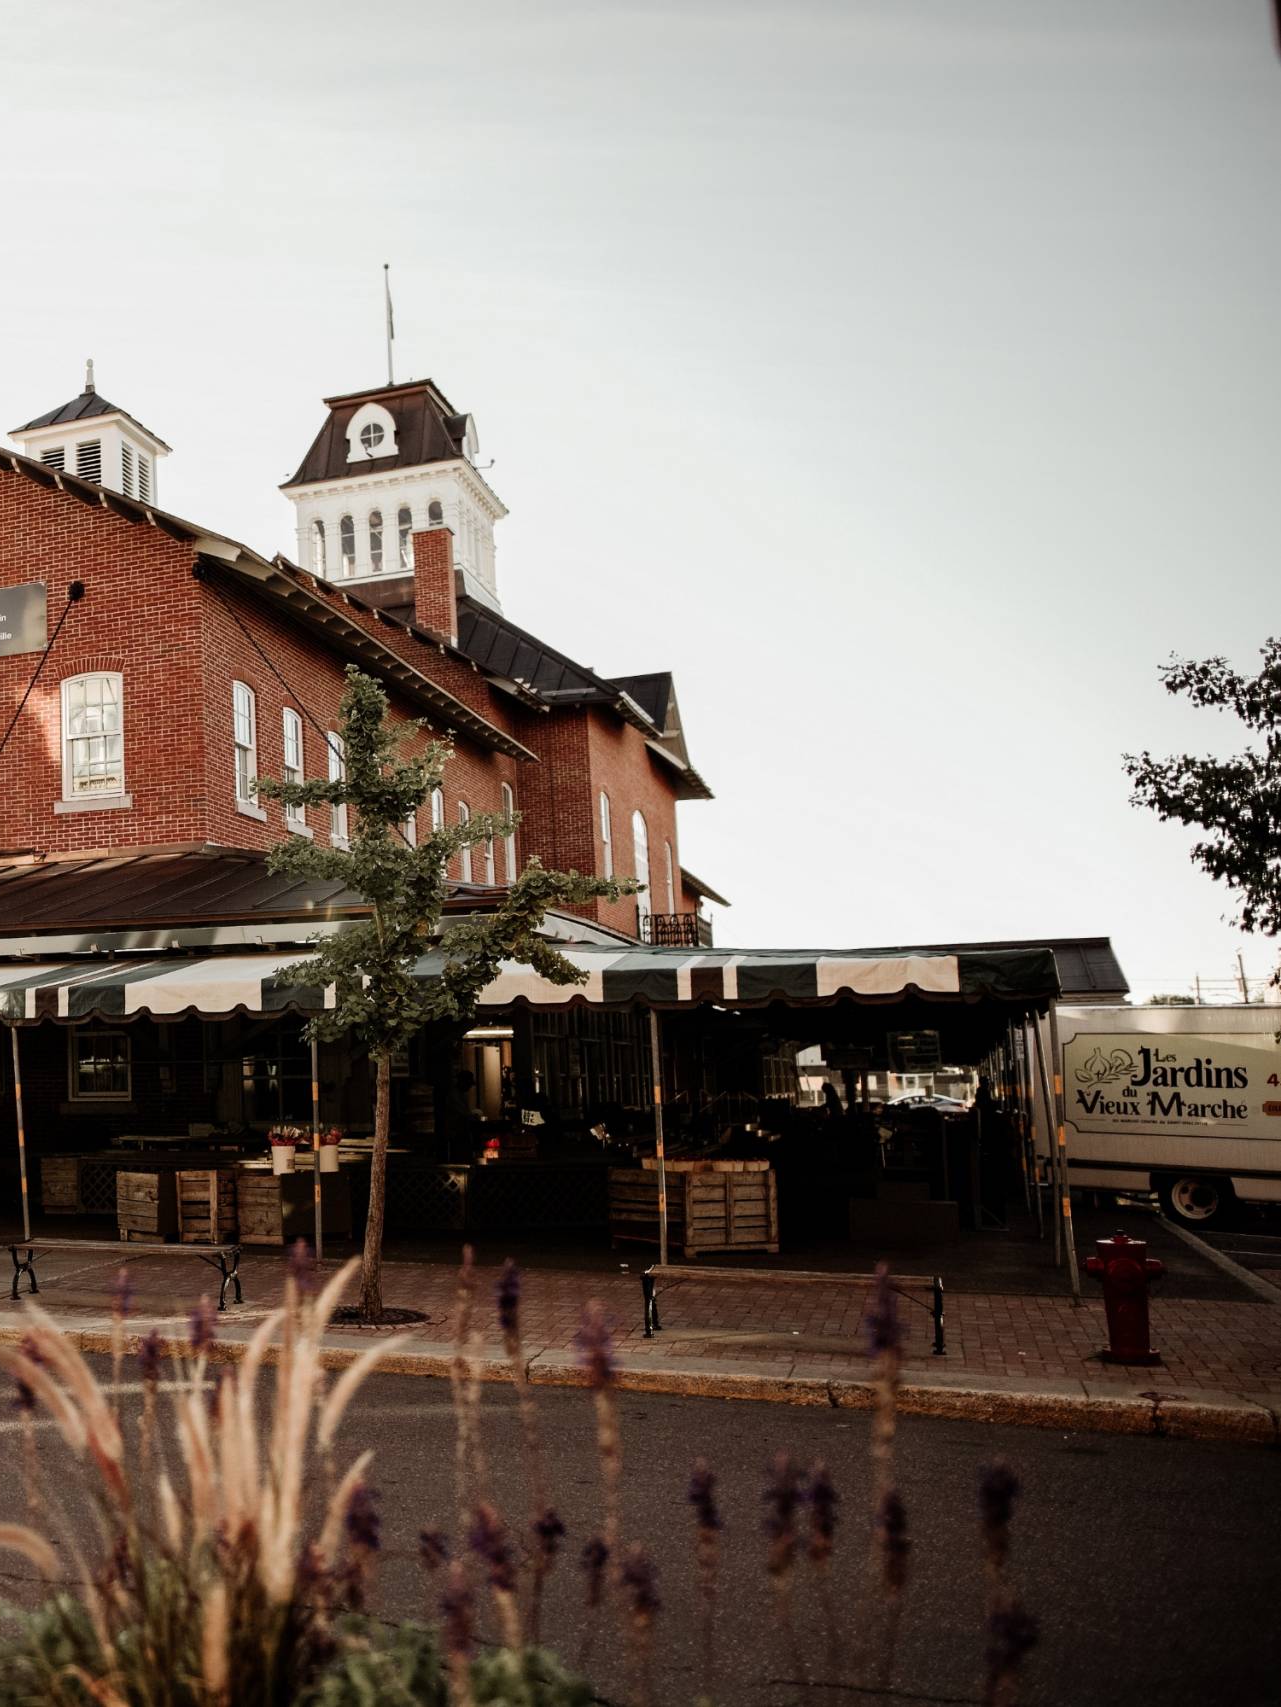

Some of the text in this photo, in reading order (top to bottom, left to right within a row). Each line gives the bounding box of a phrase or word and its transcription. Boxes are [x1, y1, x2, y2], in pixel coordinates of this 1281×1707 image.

[1153, 1048, 1177, 1063] Les
[1131, 1044, 1248, 1089] Jardins
[1266, 1073, 1281, 1087] 4
[1122, 1085, 1138, 1098] du
[1076, 1088, 1248, 1119] Vieux Marché
